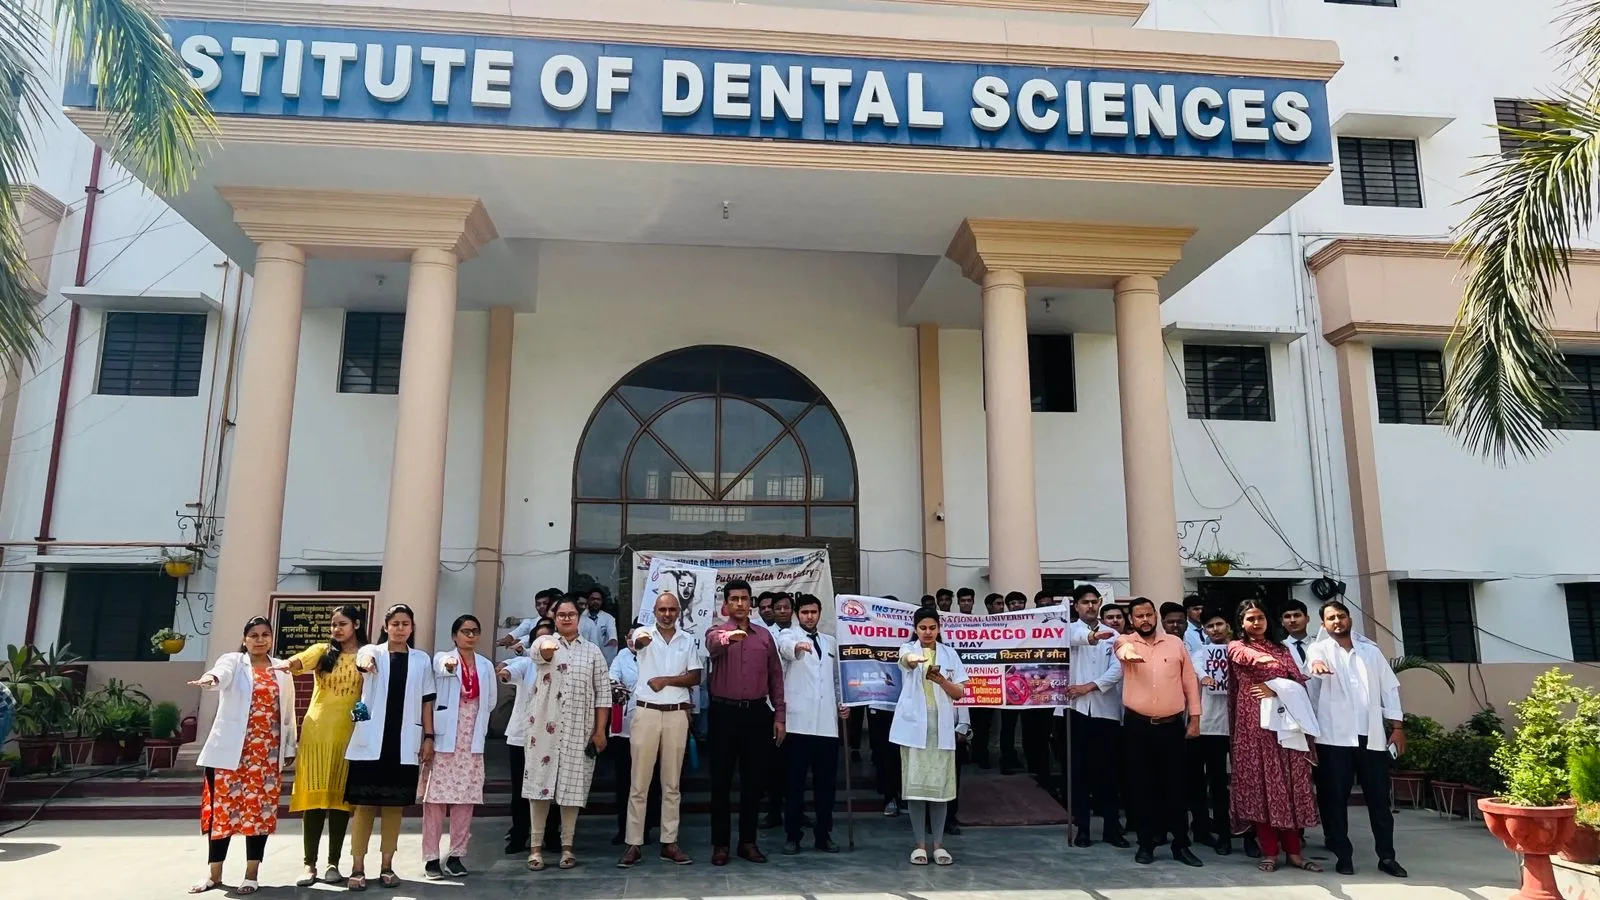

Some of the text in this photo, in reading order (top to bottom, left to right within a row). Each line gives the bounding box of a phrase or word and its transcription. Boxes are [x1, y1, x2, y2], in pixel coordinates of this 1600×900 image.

[90, 28, 1312, 145] STITUTE OF DENTAL SCIENCES
[709, 559, 735, 568] Dental
[745, 571, 774, 581] Health
[777, 569, 815, 579] Dentistry
[698, 609, 708, 617] OF
[872, 604, 914, 615] INSTITU
[985, 613, 1035, 622] UNIVERSITY
[848, 624, 910, 638] WORLD
[944, 629, 1026, 640] TOBACCO
[1031, 627, 1065, 639] DAY
[961, 652, 997, 660] मतलब
[1000, 649, 1032, 660] किस्तों
[1034, 649, 1044, 659] में
[1047, 648, 1067, 659] मौत
[972, 686, 1001, 695] Tobacco
[977, 695, 1002, 704] Cancer
